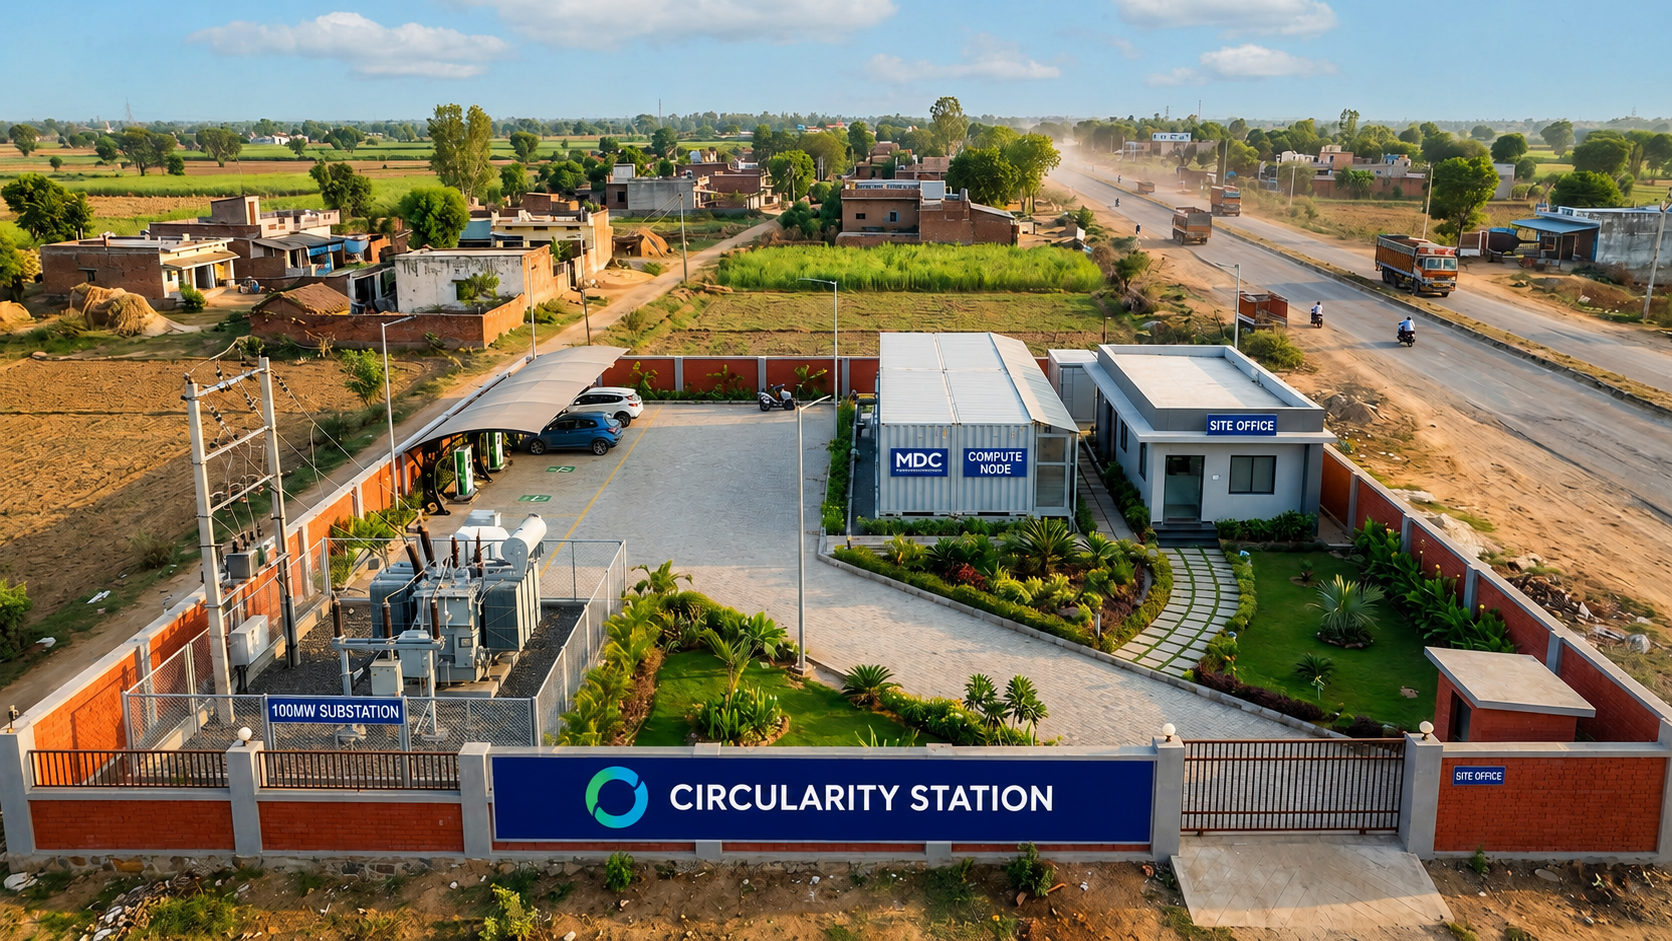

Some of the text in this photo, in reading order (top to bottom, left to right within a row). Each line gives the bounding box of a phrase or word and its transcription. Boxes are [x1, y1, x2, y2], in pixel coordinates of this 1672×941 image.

[1209, 420, 1274, 431] SITE OFFICE
[896, 452, 942, 468] MDC
[968, 451, 1023, 462] COMPUTE
[980, 463, 1012, 475] NODE
[271, 703, 399, 719] 100MW SUBSTATION
[1455, 771, 1503, 781] SITE OFFICE
[669, 783, 1054, 813] CIRCULARITY STATION
